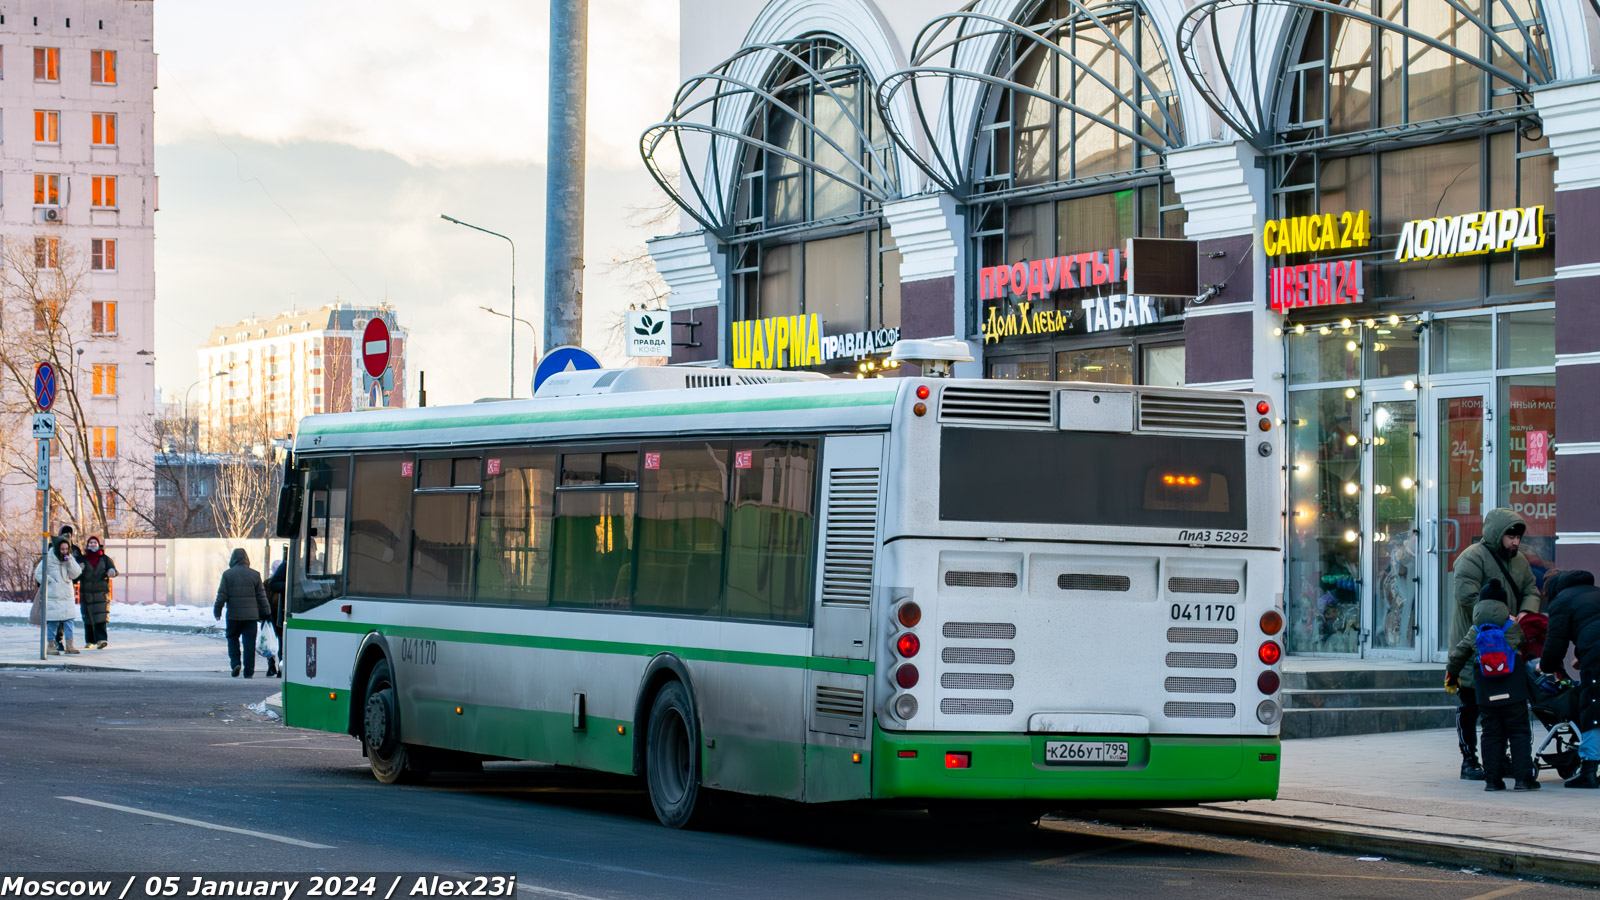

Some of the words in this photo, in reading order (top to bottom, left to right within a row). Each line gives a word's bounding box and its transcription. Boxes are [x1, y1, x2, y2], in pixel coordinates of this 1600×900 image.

[1264, 213, 1336, 257] САМСА
[1340, 209, 1367, 249] 24
[1395, 205, 1545, 262] ЛОМБАРД
[980, 249, 1116, 301] ПРОДУКТЫ
[1271, 262, 1331, 314] ЦВЕТЫ
[1336, 259, 1359, 304] 24
[1081, 295, 1154, 333] ТАБАК
[732, 313, 821, 369] ШАУРМА
[821, 331, 876, 361] ПРАВДА
[875, 326, 900, 348] КОФЕ
[40, 465, 47, 476] 15
[1215, 531, 1248, 543] 5292
[1171, 603, 1236, 622] 041170
[401, 638, 437, 666] 041170
[1105, 743, 1126, 755] 799
